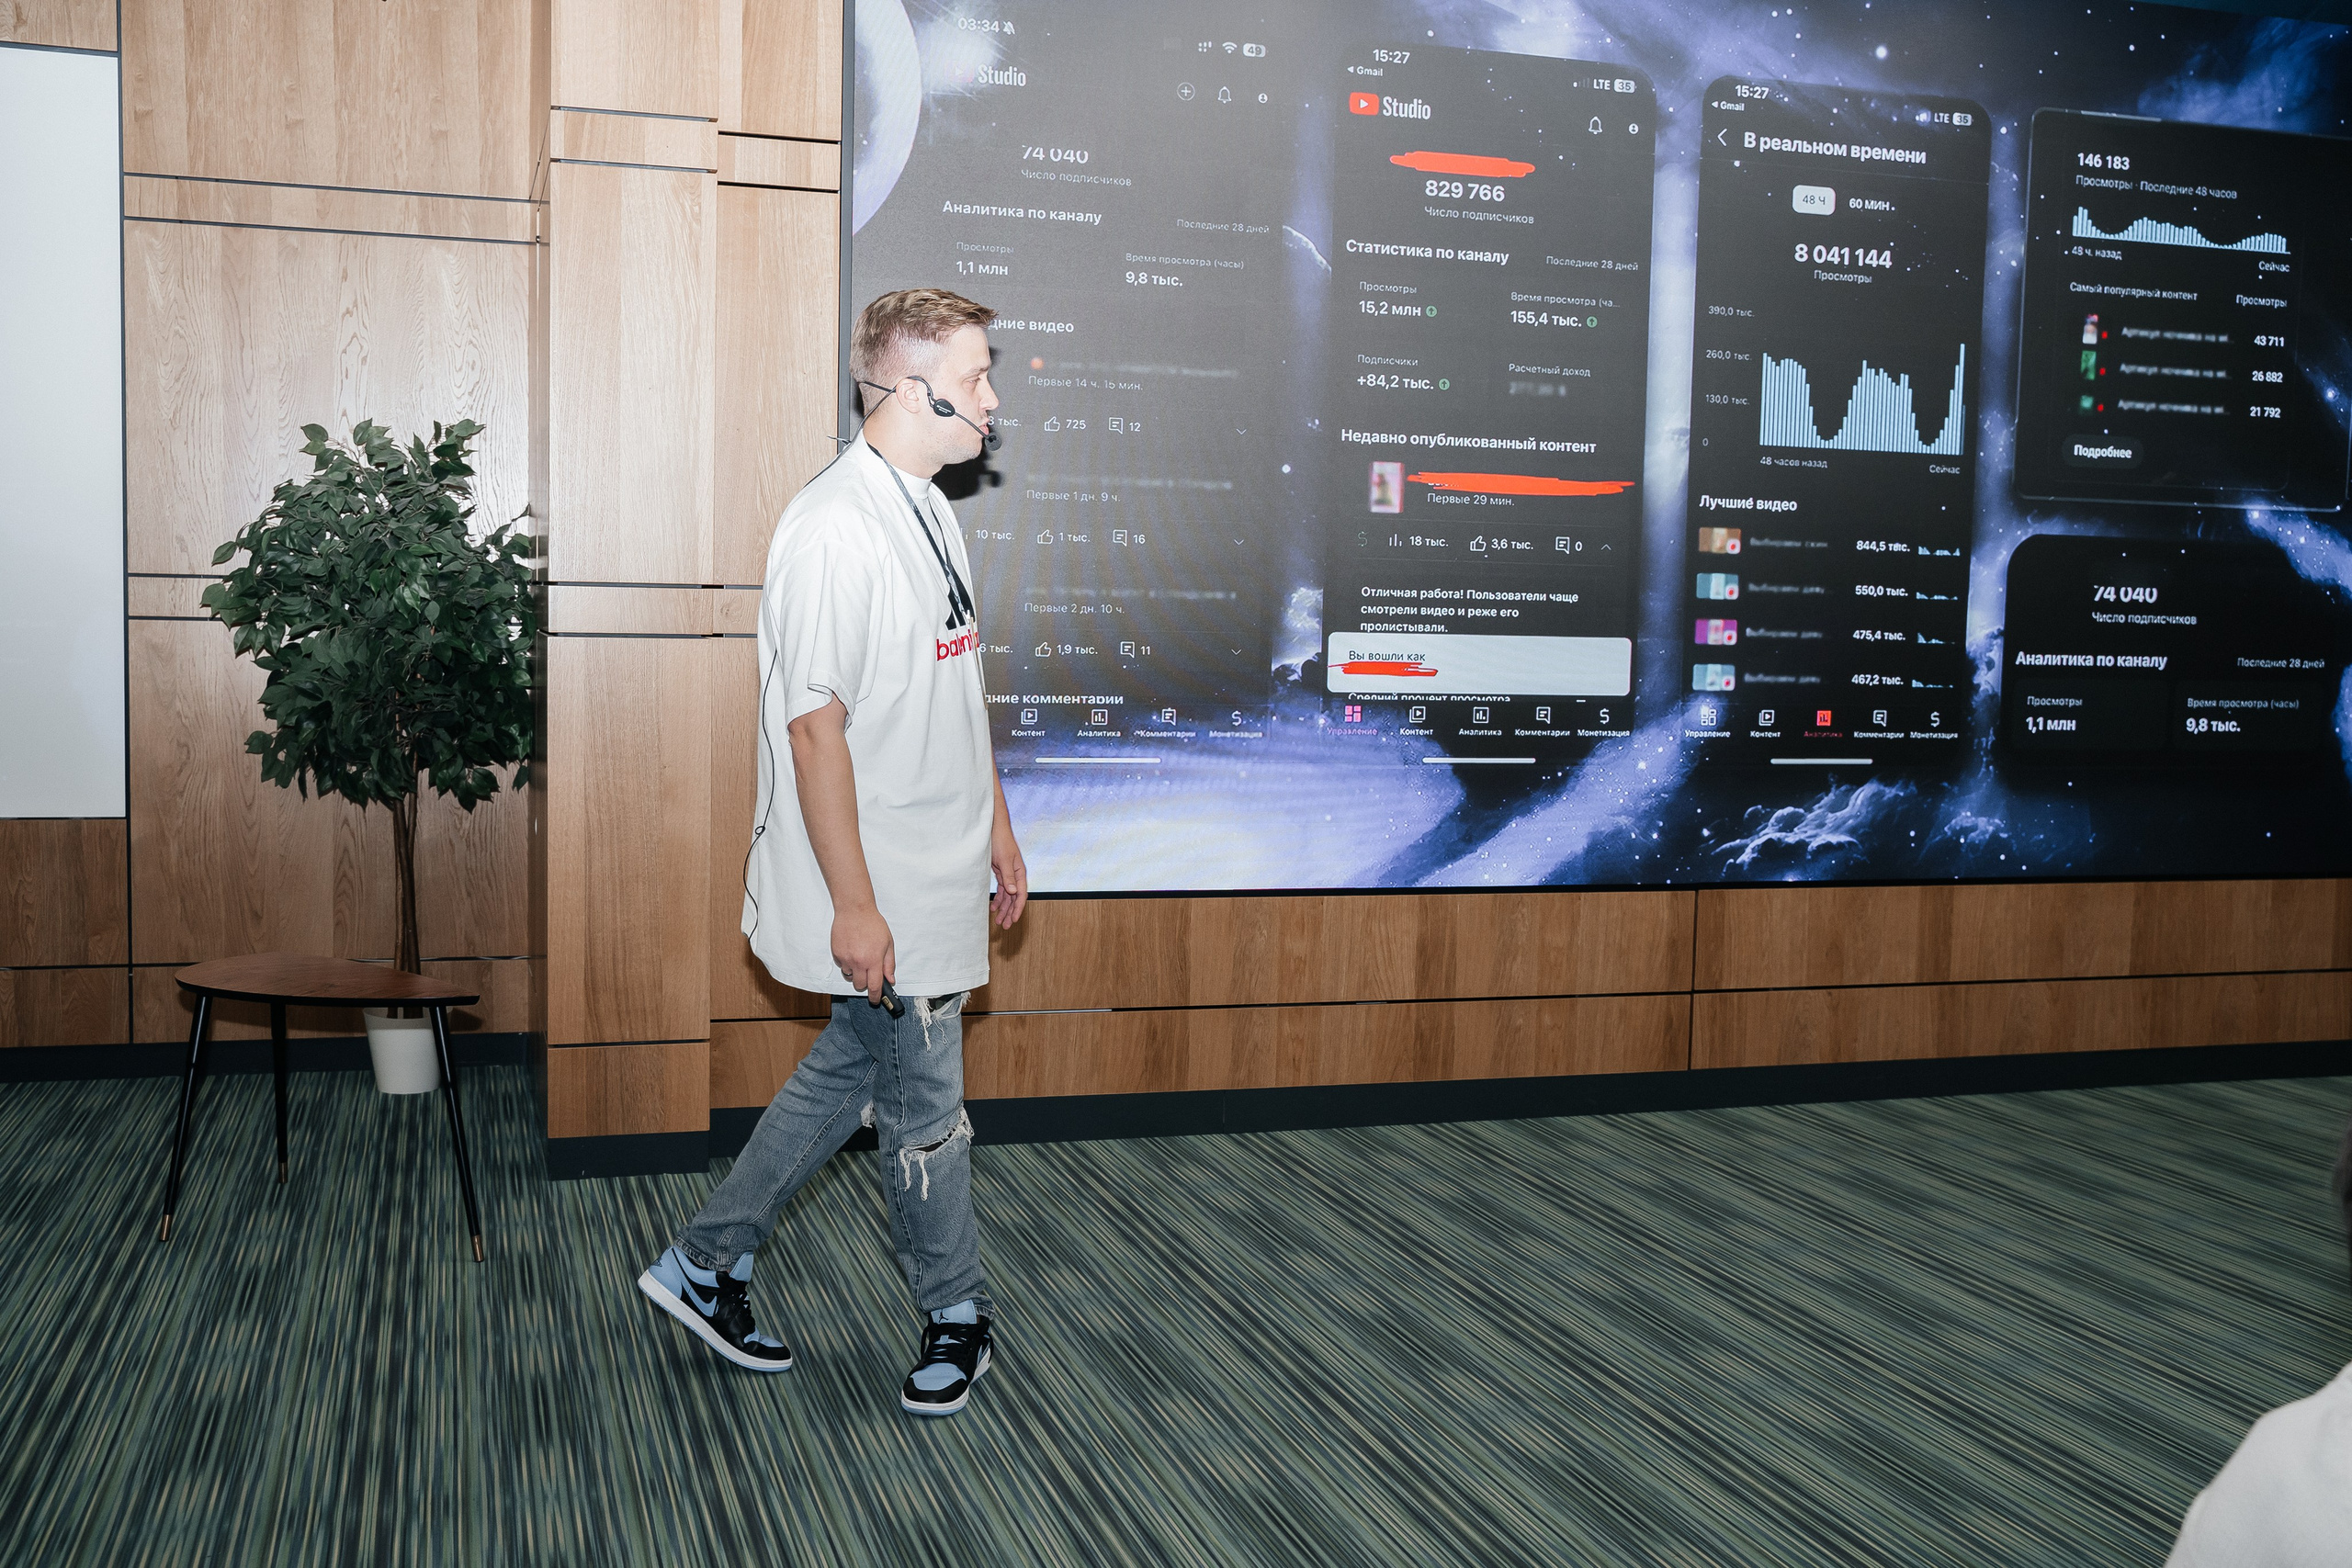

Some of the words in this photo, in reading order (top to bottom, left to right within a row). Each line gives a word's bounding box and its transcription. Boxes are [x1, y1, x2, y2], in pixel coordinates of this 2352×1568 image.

[958, 18, 1000, 33] 03:34
[1248, 45, 1262, 55] 49
[1373, 50, 1410, 63] 15:27
[978, 65, 1026, 86] Studio
[1357, 66, 1383, 76] Gmail
[1593, 79, 1610, 90] LTE
[1618, 82, 1632, 91] 35
[1735, 85, 1770, 99] 15:27
[1383, 96, 1431, 119] Studio
[1720, 101, 1745, 111] Gmail
[1934, 113, 1950, 123] LTE
[1956, 115, 1969, 124] 35
[1744, 131, 1757, 148] В
[1759, 135, 1847, 157] реальном
[1850, 144, 1927, 164] времени
[1022, 145, 1045, 161] 74
[1049, 148, 1089, 164] 040
[2078, 152, 2102, 168] 146
[2106, 155, 2130, 170] 183
[1021, 169, 1056, 181] Число
[1059, 174, 1132, 186] подписчиков
[1425, 180, 1463, 197] 829
[1467, 184, 1505, 201] 766
[2075, 175, 2132, 190] Просмотры
[2140, 181, 2193, 196] Последние
[2195, 186, 2207, 197] 48
[2210, 188, 2237, 199] часов
[1803, 194, 1815, 205] 48
[1849, 198, 1862, 209] 60
[943, 201, 1024, 218] Аналитика
[1028, 209, 1046, 219] по
[1049, 209, 1102, 225] каналу
[1424, 206, 1459, 219] Число
[1463, 210, 1534, 224] подписчиков
[1177, 220, 1229, 231] Последние
[1232, 223, 1243, 232] 28
[1247, 224, 1270, 234] дней
[956, 242, 1013, 254] Просмотры
[1346, 240, 1431, 258] Статистика
[1436, 247, 1454, 259] по
[1458, 248, 1509, 265] каналу
[1125, 254, 1156, 264] Время
[1159, 256, 1211, 267] просмотра
[1794, 243, 1808, 262] 8
[1813, 245, 1849, 265] 041
[1855, 248, 1893, 268] 144
[956, 261, 975, 276] 1,1
[978, 264, 1009, 276] млн
[1546, 256, 1598, 268] Последние
[1601, 260, 1612, 269] 28
[1615, 262, 1638, 271] дней
[2258, 261, 2290, 272] Сейчас
[1125, 272, 1148, 287] 9,8
[1151, 274, 1183, 287] тыс.
[1814, 269, 1872, 283] Просмотры
[1360, 282, 1417, 295] Просмотры
[2070, 281, 2102, 293] Самый
[2105, 286, 2160, 299] популярный
[2163, 290, 2198, 300] контент
[1511, 292, 1542, 302] Время
[1544, 295, 1596, 307] просмотра
[2236, 294, 2287, 308] Просмотры
[1359, 300, 1388, 317] 15,2
[1392, 303, 1421, 316] млн
[1709, 306, 1734, 316] 390,0
[1510, 310, 1548, 325] 155,4
[1552, 314, 1582, 327] тыс.
[1028, 321, 1074, 333] видео
[2255, 335, 2267, 346] 43
[2268, 336, 2284, 347] 711
[1357, 355, 1419, 367] Подписчики
[1706, 350, 1731, 360] 260,0
[1509, 364, 1560, 375] Расчетный
[1563, 367, 1591, 378] доход
[2252, 371, 2264, 382] 26
[2266, 372, 2282, 383] 882
[1028, 376, 1071, 388] Первые
[1075, 378, 1087, 387] 14
[1357, 374, 1399, 390] +84,2
[1403, 377, 1434, 390] тыс.
[1705, 394, 1728, 404] 130,0
[2250, 407, 2263, 417] 21
[2265, 407, 2280, 419] 792
[1066, 419, 1086, 429] 725
[1129, 423, 1141, 432] 12
[1341, 429, 1407, 446] Недавно
[1410, 433, 1536, 451] опубликованный
[1540, 439, 1596, 453] контент
[2074, 445, 2132, 459] Подробнее
[1759, 457, 1771, 465] 48
[1027, 490, 1069, 502] Первые
[1428, 493, 1471, 505] Первые
[1474, 494, 1487, 505] 29
[1490, 497, 1514, 506] мин.
[1699, 495, 1754, 510] Лучшие
[1757, 498, 1797, 511] видео
[975, 529, 988, 539] 10
[991, 530, 1015, 540] тыс.
[1068, 533, 1091, 542] тыс.
[1133, 534, 1145, 544] 16
[1409, 536, 1422, 546] 18
[1425, 536, 1449, 547] тыс.
[1491, 539, 1508, 550] 3,6
[1510, 539, 1533, 550] тыс.
[1856, 540, 1885, 552] 844,5
[1362, 587, 1417, 598] Отличная
[1419, 589, 1464, 601] работа!
[1466, 590, 1546, 602] Пользователи
[1549, 592, 1578, 603] чаще
[1855, 586, 1883, 597] 550,0
[1886, 587, 1908, 596] тыс.
[2094, 585, 2116, 603] 74
[2120, 586, 2157, 604] 040
[1024, 603, 1068, 615] Первые
[1101, 604, 1113, 613] 10
[1361, 605, 1418, 617] смотрели
[1420, 607, 1455, 616] видео
[1458, 608, 1464, 616] и
[1468, 608, 1498, 618] реже
[1499, 608, 1519, 618] его
[2092, 612, 2125, 623] Число
[2128, 614, 2197, 625] подписчиков
[1361, 623, 1448, 633] пролистывали.
[1853, 630, 1882, 641] 475,4
[1884, 632, 1905, 641] тыс.
[990, 644, 1012, 653] тыс.
[1057, 644, 1071, 657] 1,9
[1075, 645, 1098, 655] тыс.
[1141, 646, 1150, 655] 11
[1349, 650, 1365, 660] Вы
[1368, 652, 1404, 661] вошли
[1408, 653, 1425, 661] как
[2016, 651, 2094, 667] Аналитика
[2097, 655, 2114, 667] по
[2117, 655, 2167, 671] каналу
[2290, 659, 2301, 668] 28
[2302, 660, 2324, 669] дней
[1851, 674, 1879, 686] 467,2
[1882, 676, 1904, 685] тыс.
[2027, 695, 2083, 707] Просмотры
[2188, 698, 2216, 708] Время
[2219, 700, 2267, 710] просмотра
[2026, 716, 2044, 733] 1,1
[2047, 718, 2076, 731] млн
[2186, 718, 2208, 734] 9,8
[2211, 720, 2240, 732] тыс.
[1400, 728, 1433, 736] Контент
[1459, 728, 1502, 736] Аналитика
[1750, 730, 1781, 739] Контент
[1854, 731, 1905, 740] Комментарии
